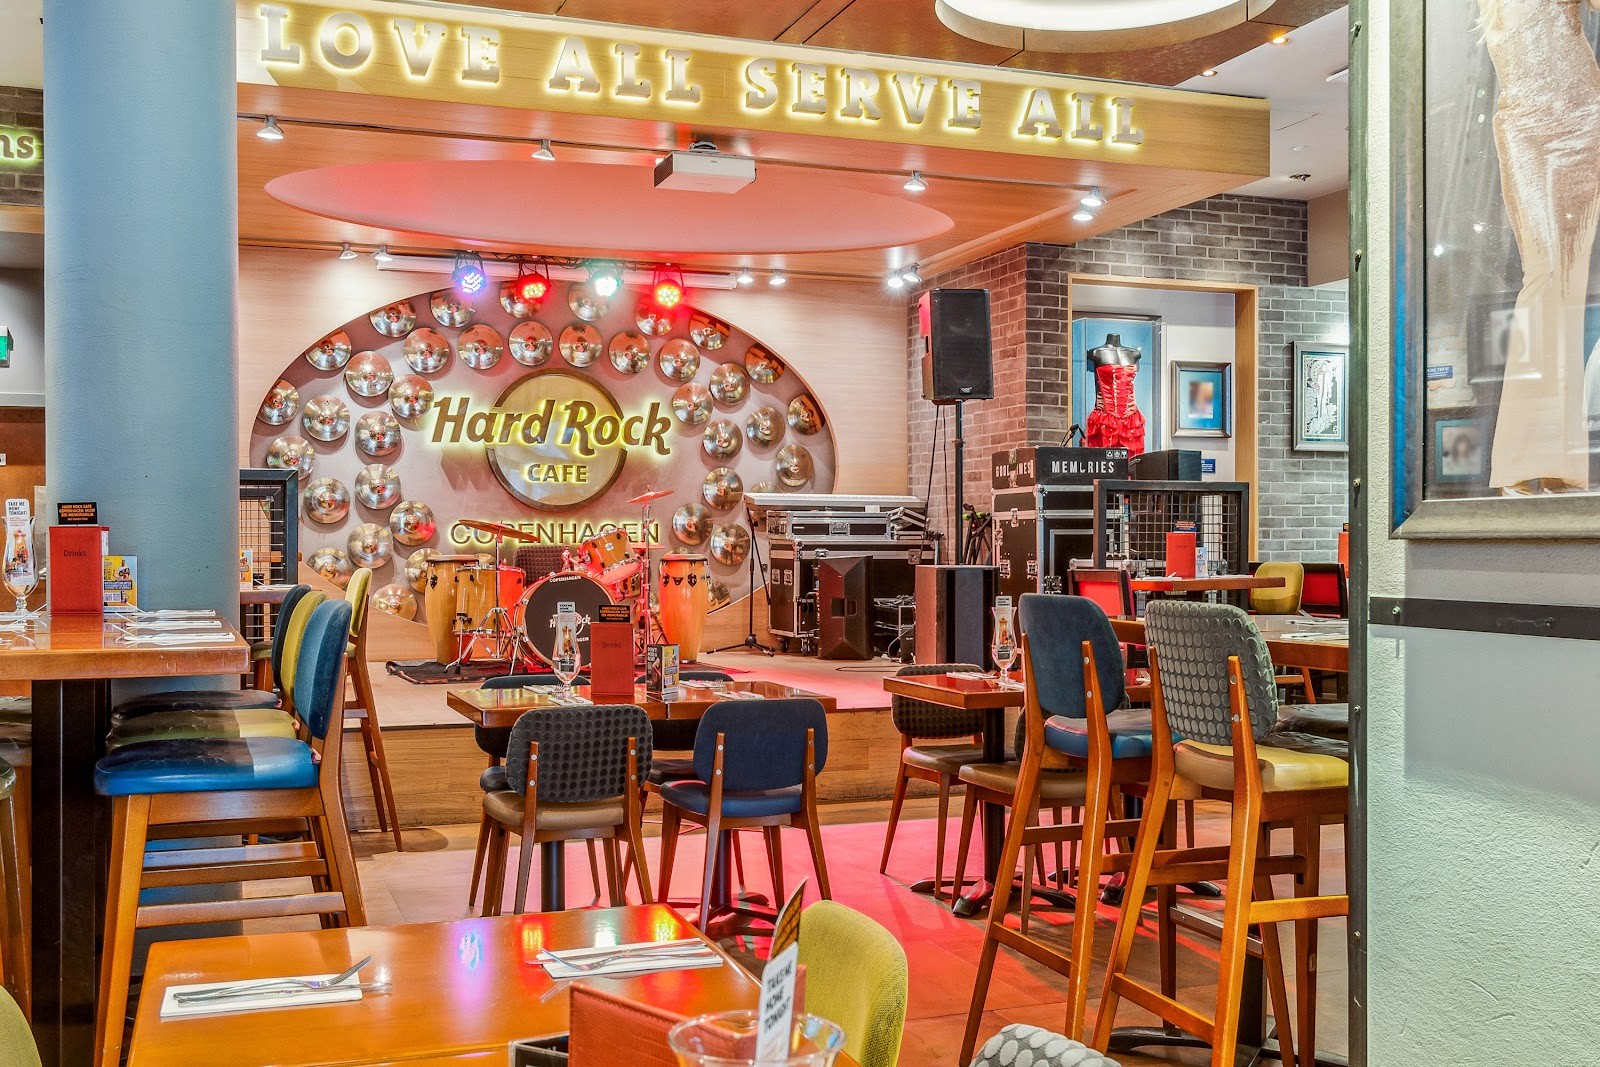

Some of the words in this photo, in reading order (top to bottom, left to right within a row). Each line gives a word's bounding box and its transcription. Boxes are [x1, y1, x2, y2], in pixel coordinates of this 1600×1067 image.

[259, 4, 501, 83] LOVE
[548, 37, 701, 103] ALL
[744, 57, 982, 129] SERVE
[1017, 88, 1144, 146] ALL
[431, 396, 555, 444] Hard
[563, 400, 672, 456] Rock
[526, 463, 588, 482] CAFE
